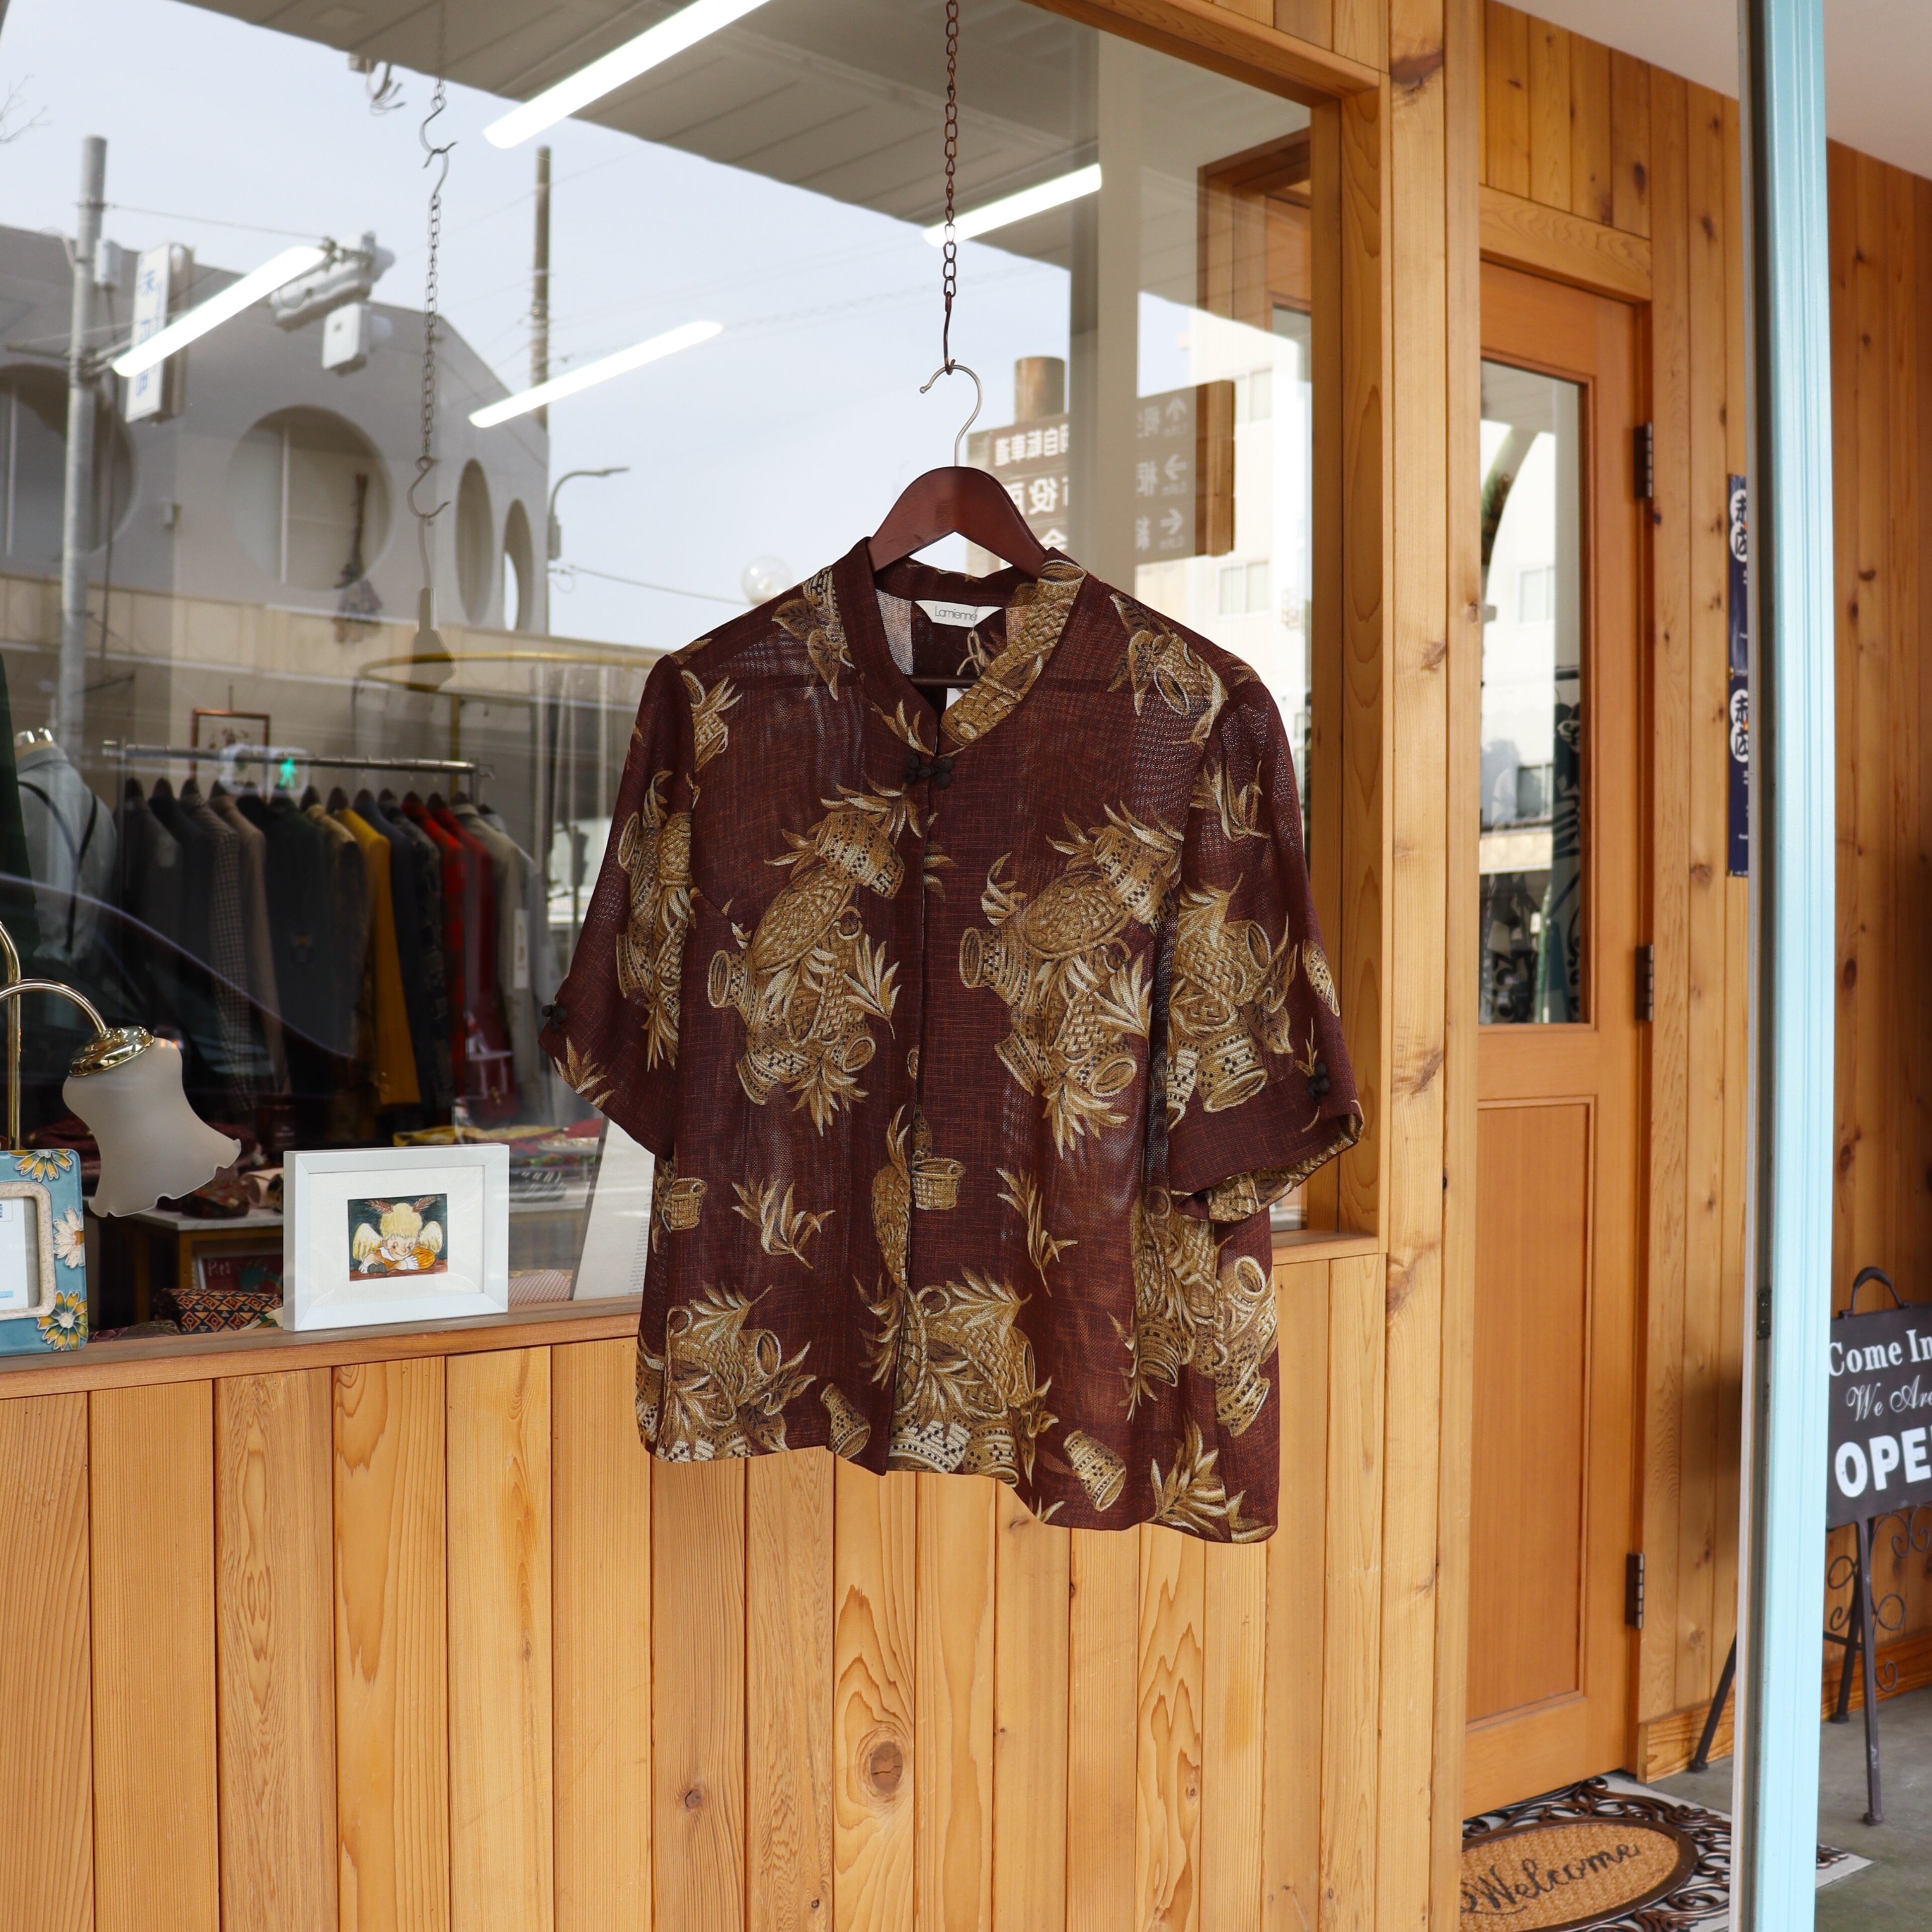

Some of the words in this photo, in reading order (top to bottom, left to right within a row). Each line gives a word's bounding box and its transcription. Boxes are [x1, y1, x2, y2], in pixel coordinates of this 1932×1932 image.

[935, 605, 977, 621] Lamienne
[1829, 1342, 1903, 1376] Come
[1906, 1329, 1932, 1362] In
[1846, 1382, 1883, 1422] We
[1835, 1424, 1932, 1498] OPE
[1461, 1844, 1640, 1913] Welcome
